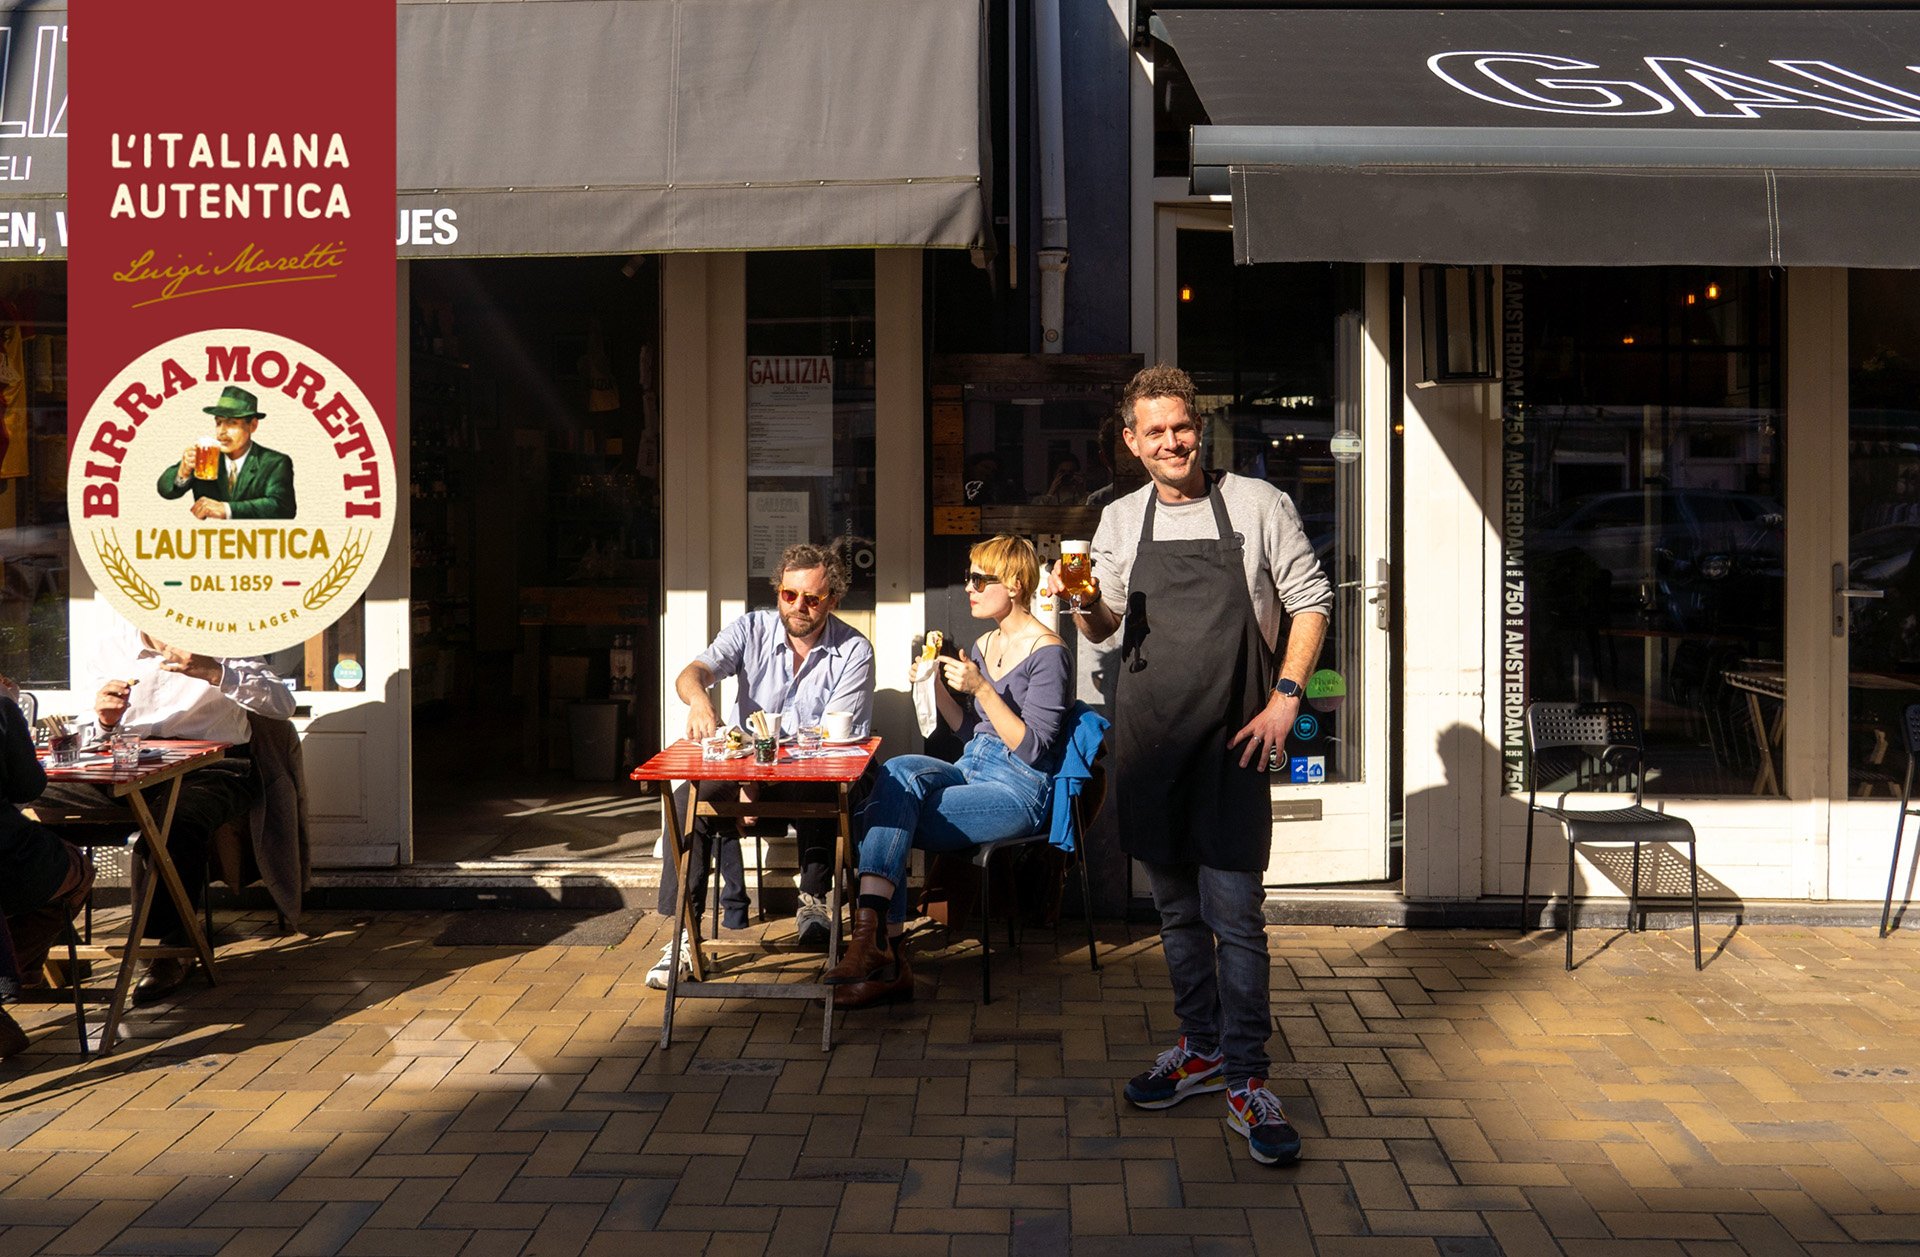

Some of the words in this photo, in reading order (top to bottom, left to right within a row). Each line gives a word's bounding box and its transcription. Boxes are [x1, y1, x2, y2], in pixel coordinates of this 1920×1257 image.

[1506, 281, 1524, 397] AMSTERDAM
[750, 358, 832, 385] GALLIZIA
[1506, 411, 1525, 445] 750
[1506, 452, 1525, 566] AMSTERDAM
[1505, 580, 1525, 615] 750
[1505, 630, 1524, 746] AMSTERDAM
[1505, 761, 1523, 793] 750
